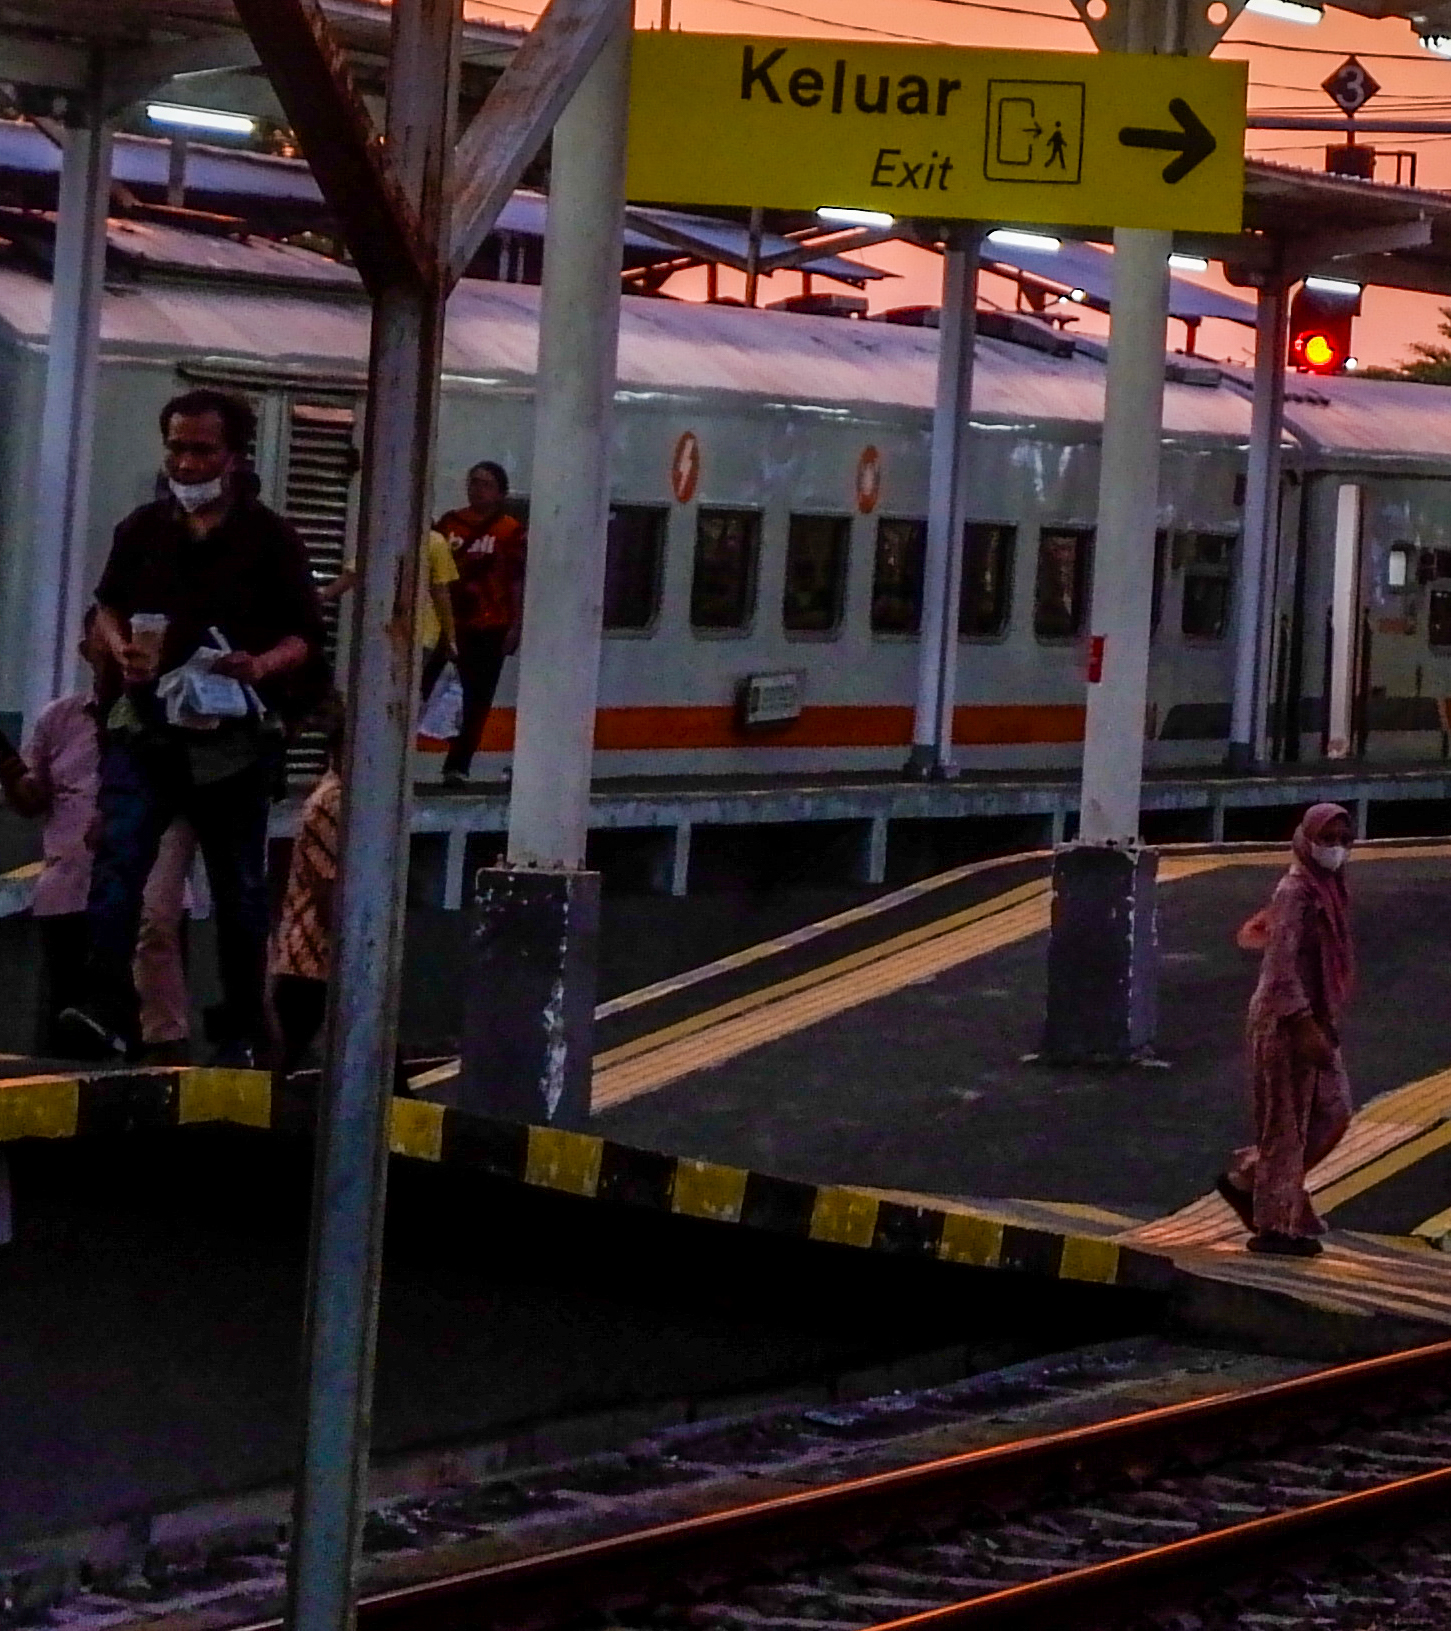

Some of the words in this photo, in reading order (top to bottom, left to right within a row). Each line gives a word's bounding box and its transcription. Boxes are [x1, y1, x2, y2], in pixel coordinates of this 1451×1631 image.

[740, 45, 961, 117] Keluar
[1337, 65, 1365, 108] 3
[871, 148, 954, 191] Exit
